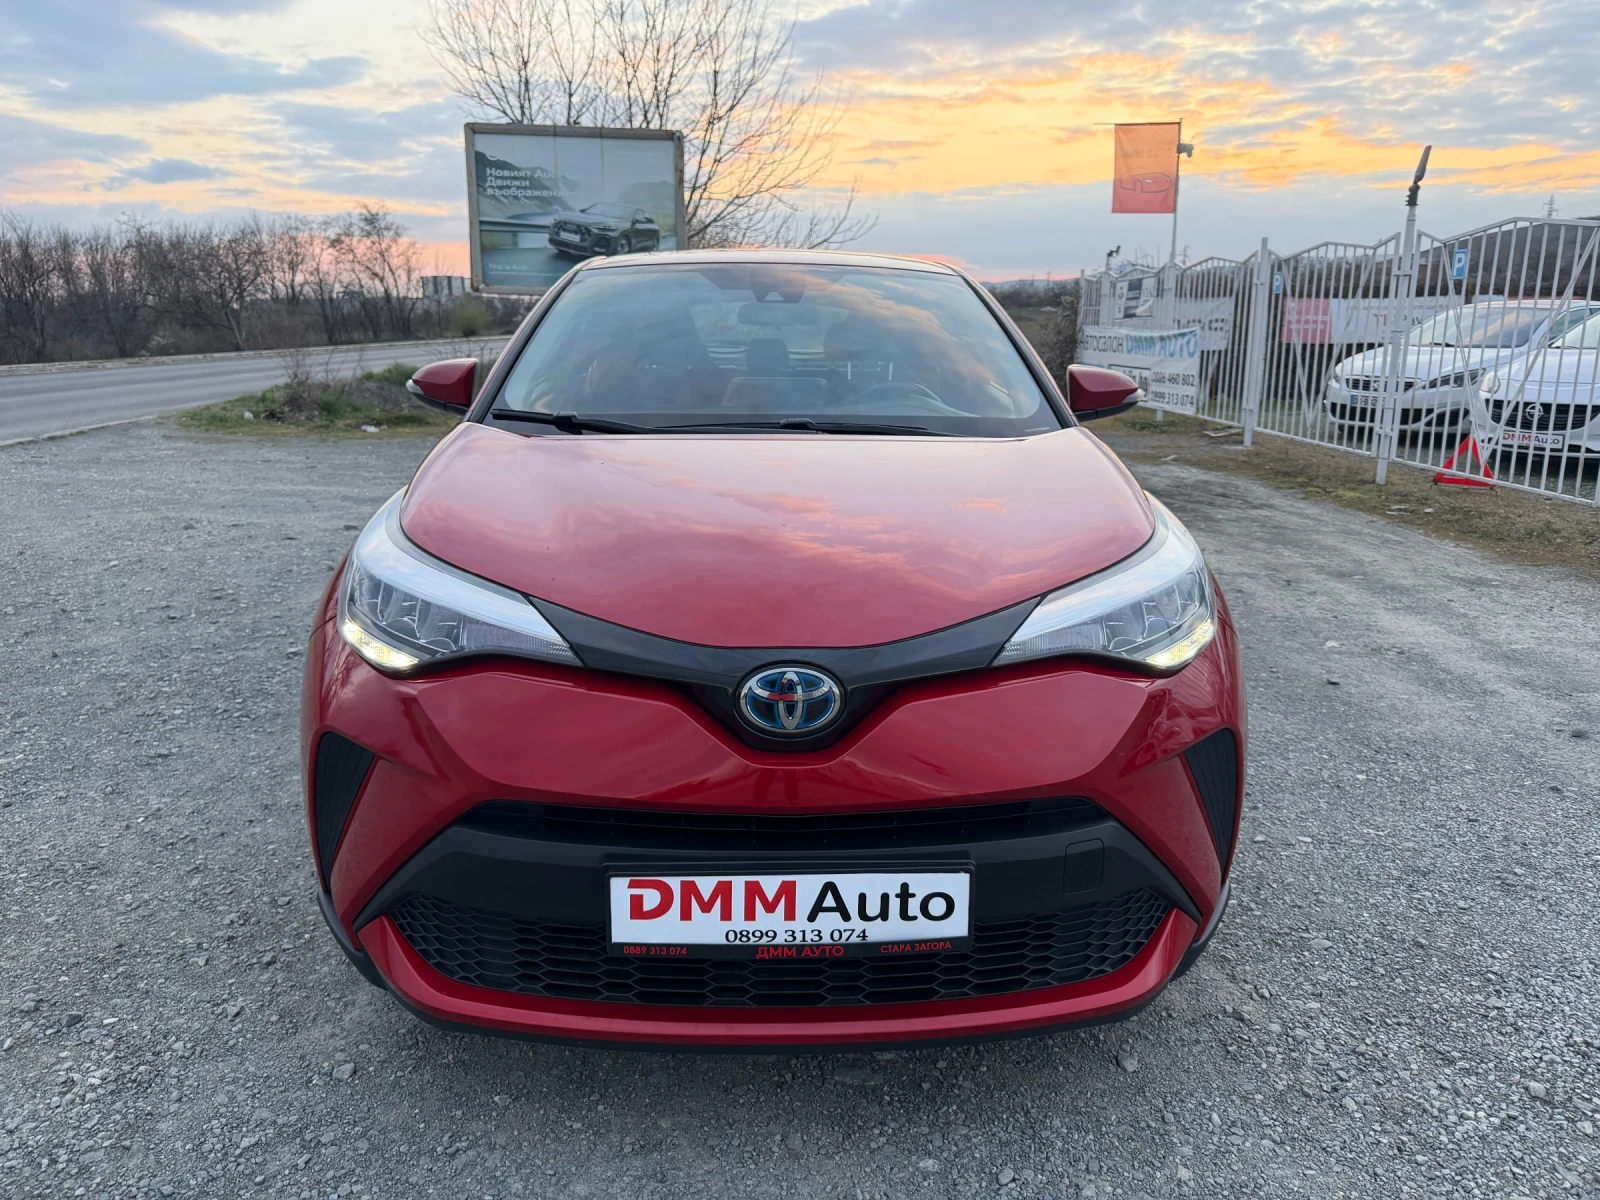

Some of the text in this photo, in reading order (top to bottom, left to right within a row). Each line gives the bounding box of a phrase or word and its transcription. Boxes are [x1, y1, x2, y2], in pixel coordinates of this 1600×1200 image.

[486, 167, 531, 178] Новият
[485, 177, 530, 187] Движи
[1453, 252, 1466, 276] P
[1274, 274, 1281, 290] P
[1125, 333, 1156, 356] DMM
[1158, 331, 1199, 359] AUTO
[1167, 372, 1180, 385] 460
[1181, 373, 1195, 387] 802
[1166, 392, 1179, 405] 313
[1180, 394, 1195, 407] 074
[1534, 435, 1560, 445] Auo
[806, 881, 955, 923] Auto
[725, 928, 869, 943] 0899 313 074
[623, 945, 688, 956] 0889 313 074
[756, 945, 845, 960] ДММ АУТО
[880, 941, 952, 954] СТАРА ЗАГОРА
